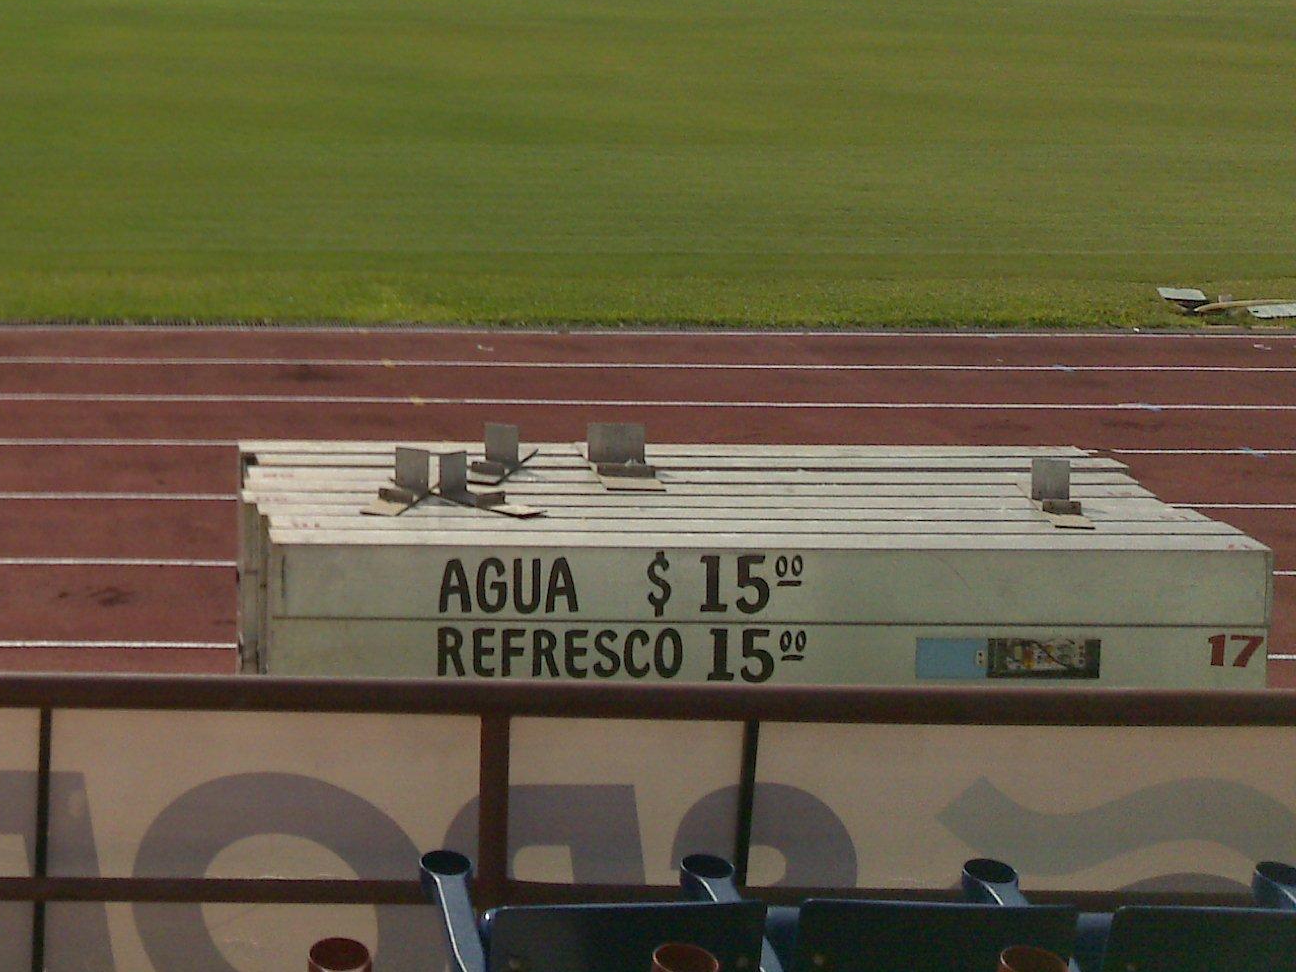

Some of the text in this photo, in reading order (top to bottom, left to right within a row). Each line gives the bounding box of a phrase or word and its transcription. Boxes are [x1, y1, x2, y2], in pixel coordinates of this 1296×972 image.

[439, 556, 579, 614] AGUA
[646, 550, 673, 618] $
[437, 626, 683, 678] REFRESCO
[1207, 633, 1265, 669] 17
